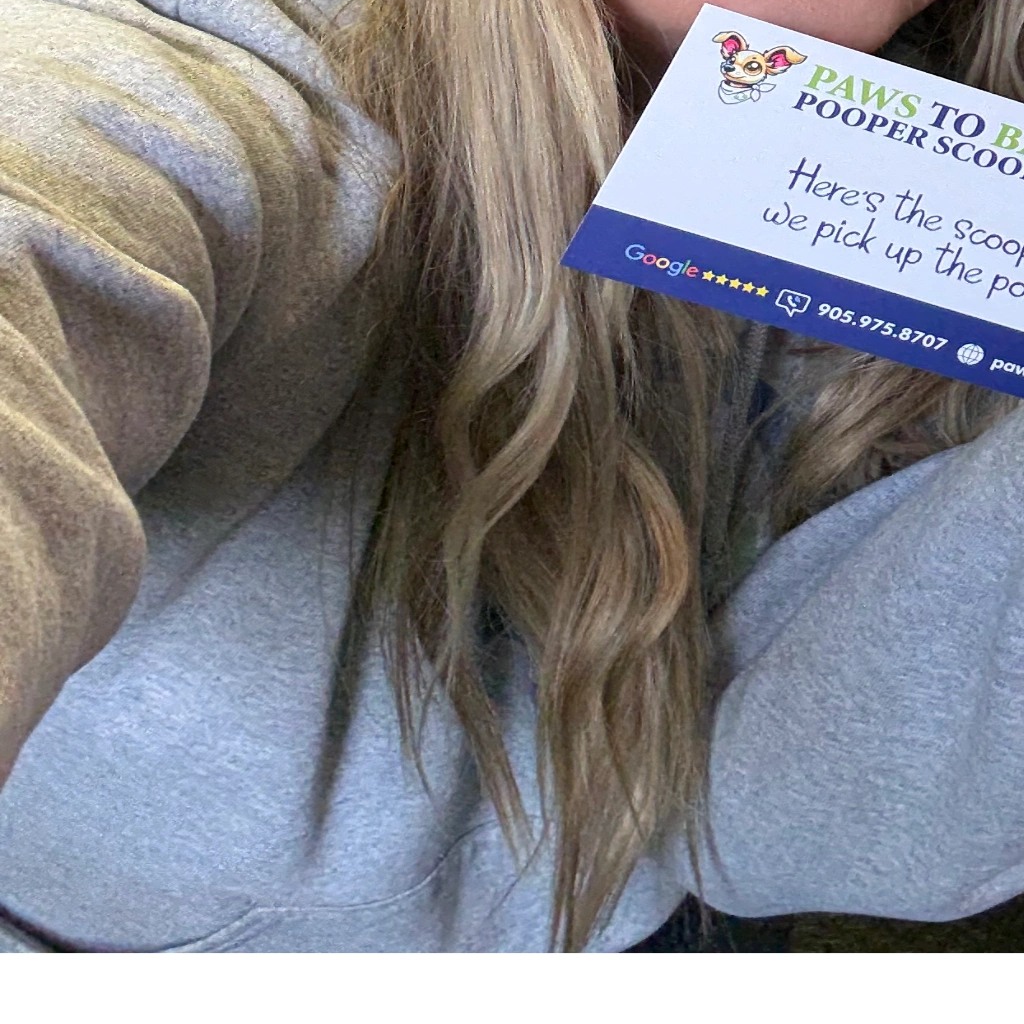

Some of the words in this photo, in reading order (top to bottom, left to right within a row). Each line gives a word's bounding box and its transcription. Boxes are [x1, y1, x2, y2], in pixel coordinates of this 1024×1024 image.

[792, 90, 929, 149] POOPER
[804, 64, 922, 119] PAWS
[928, 101, 986, 138] TO
[788, 157, 885, 213] Here's
[896, 189, 944, 232] the
[624, 243, 700, 278] Google
[763, 201, 808, 231] we
[811, 218, 878, 254] pick
[885, 241, 923, 273] up
[936, 242, 983, 284] the
[816, 303, 949, 350] 905.975.8707
